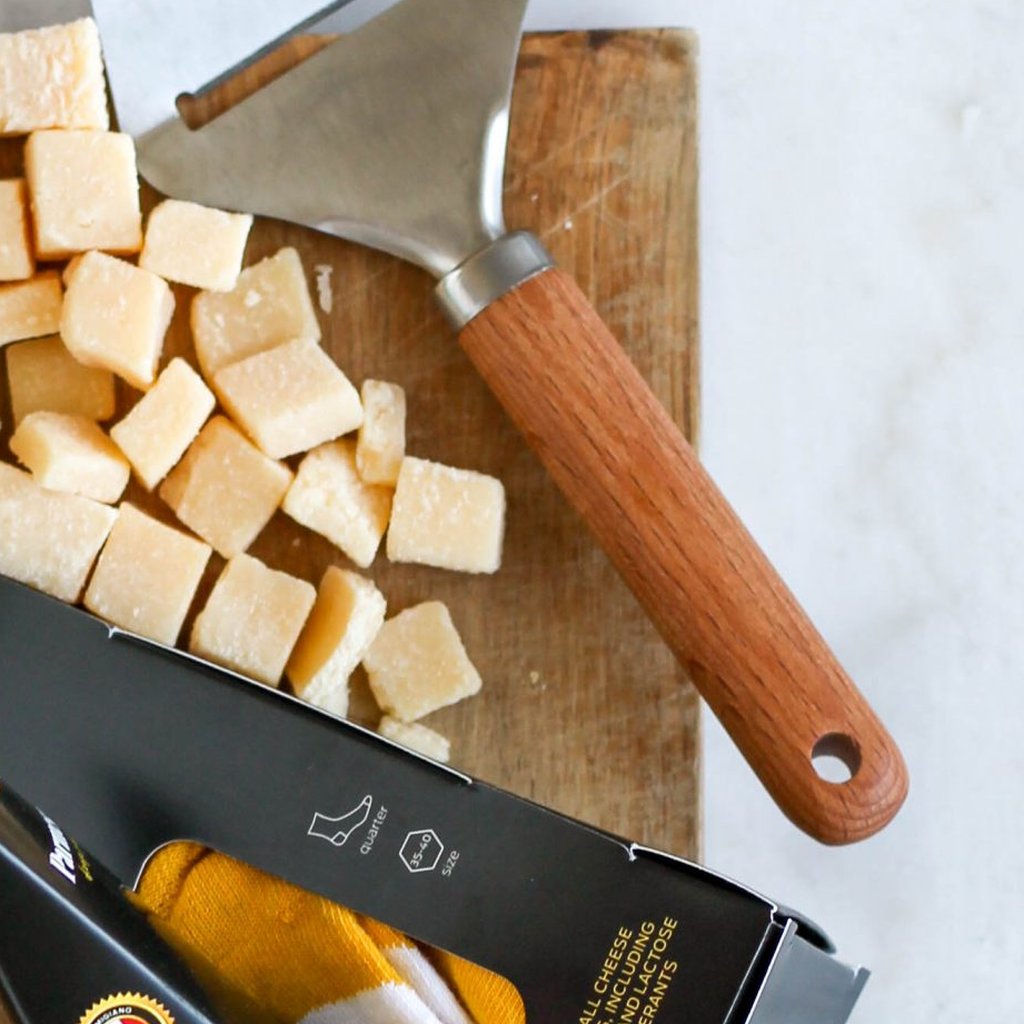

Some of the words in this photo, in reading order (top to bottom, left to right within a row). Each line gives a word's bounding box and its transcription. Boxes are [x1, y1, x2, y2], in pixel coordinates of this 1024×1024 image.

[360, 805, 389, 855] quarter
[410, 834, 432, 867] 35-40
[442, 850, 460, 877] size
[594, 927, 633, 994] CHEESE
[605, 921, 655, 1014] INCLUDING
[634, 916, 678, 995] LACTOSE
